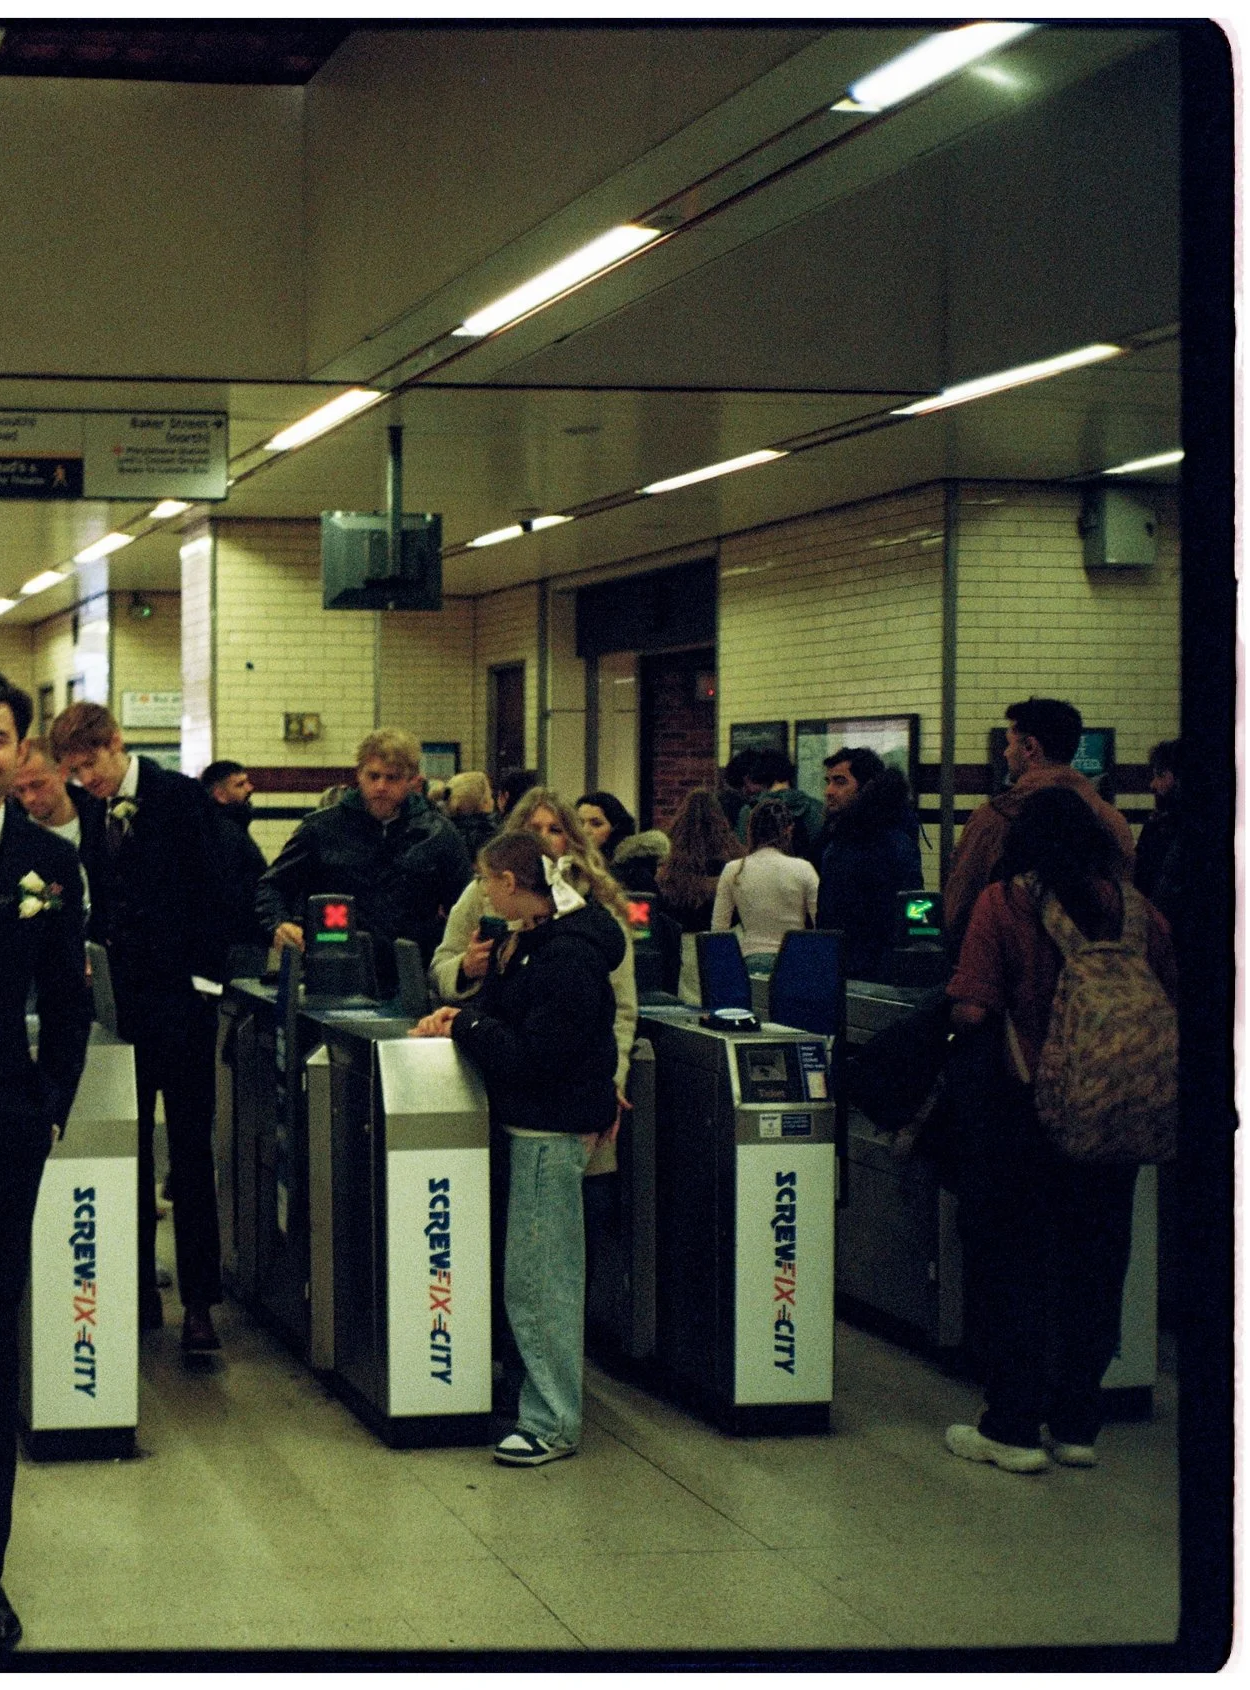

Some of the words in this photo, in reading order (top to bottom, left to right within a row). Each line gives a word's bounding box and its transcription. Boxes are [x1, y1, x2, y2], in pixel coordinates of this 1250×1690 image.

[68, 1186, 97, 1327] SCREWFIX
[424, 1177, 452, 1319] SCREWFIX
[770, 1171, 797, 1310] SCREWFIX
[74, 1340, 97, 1399] CITY
[430, 1332, 452, 1391] CITY
[774, 1322, 796, 1380] CITY
